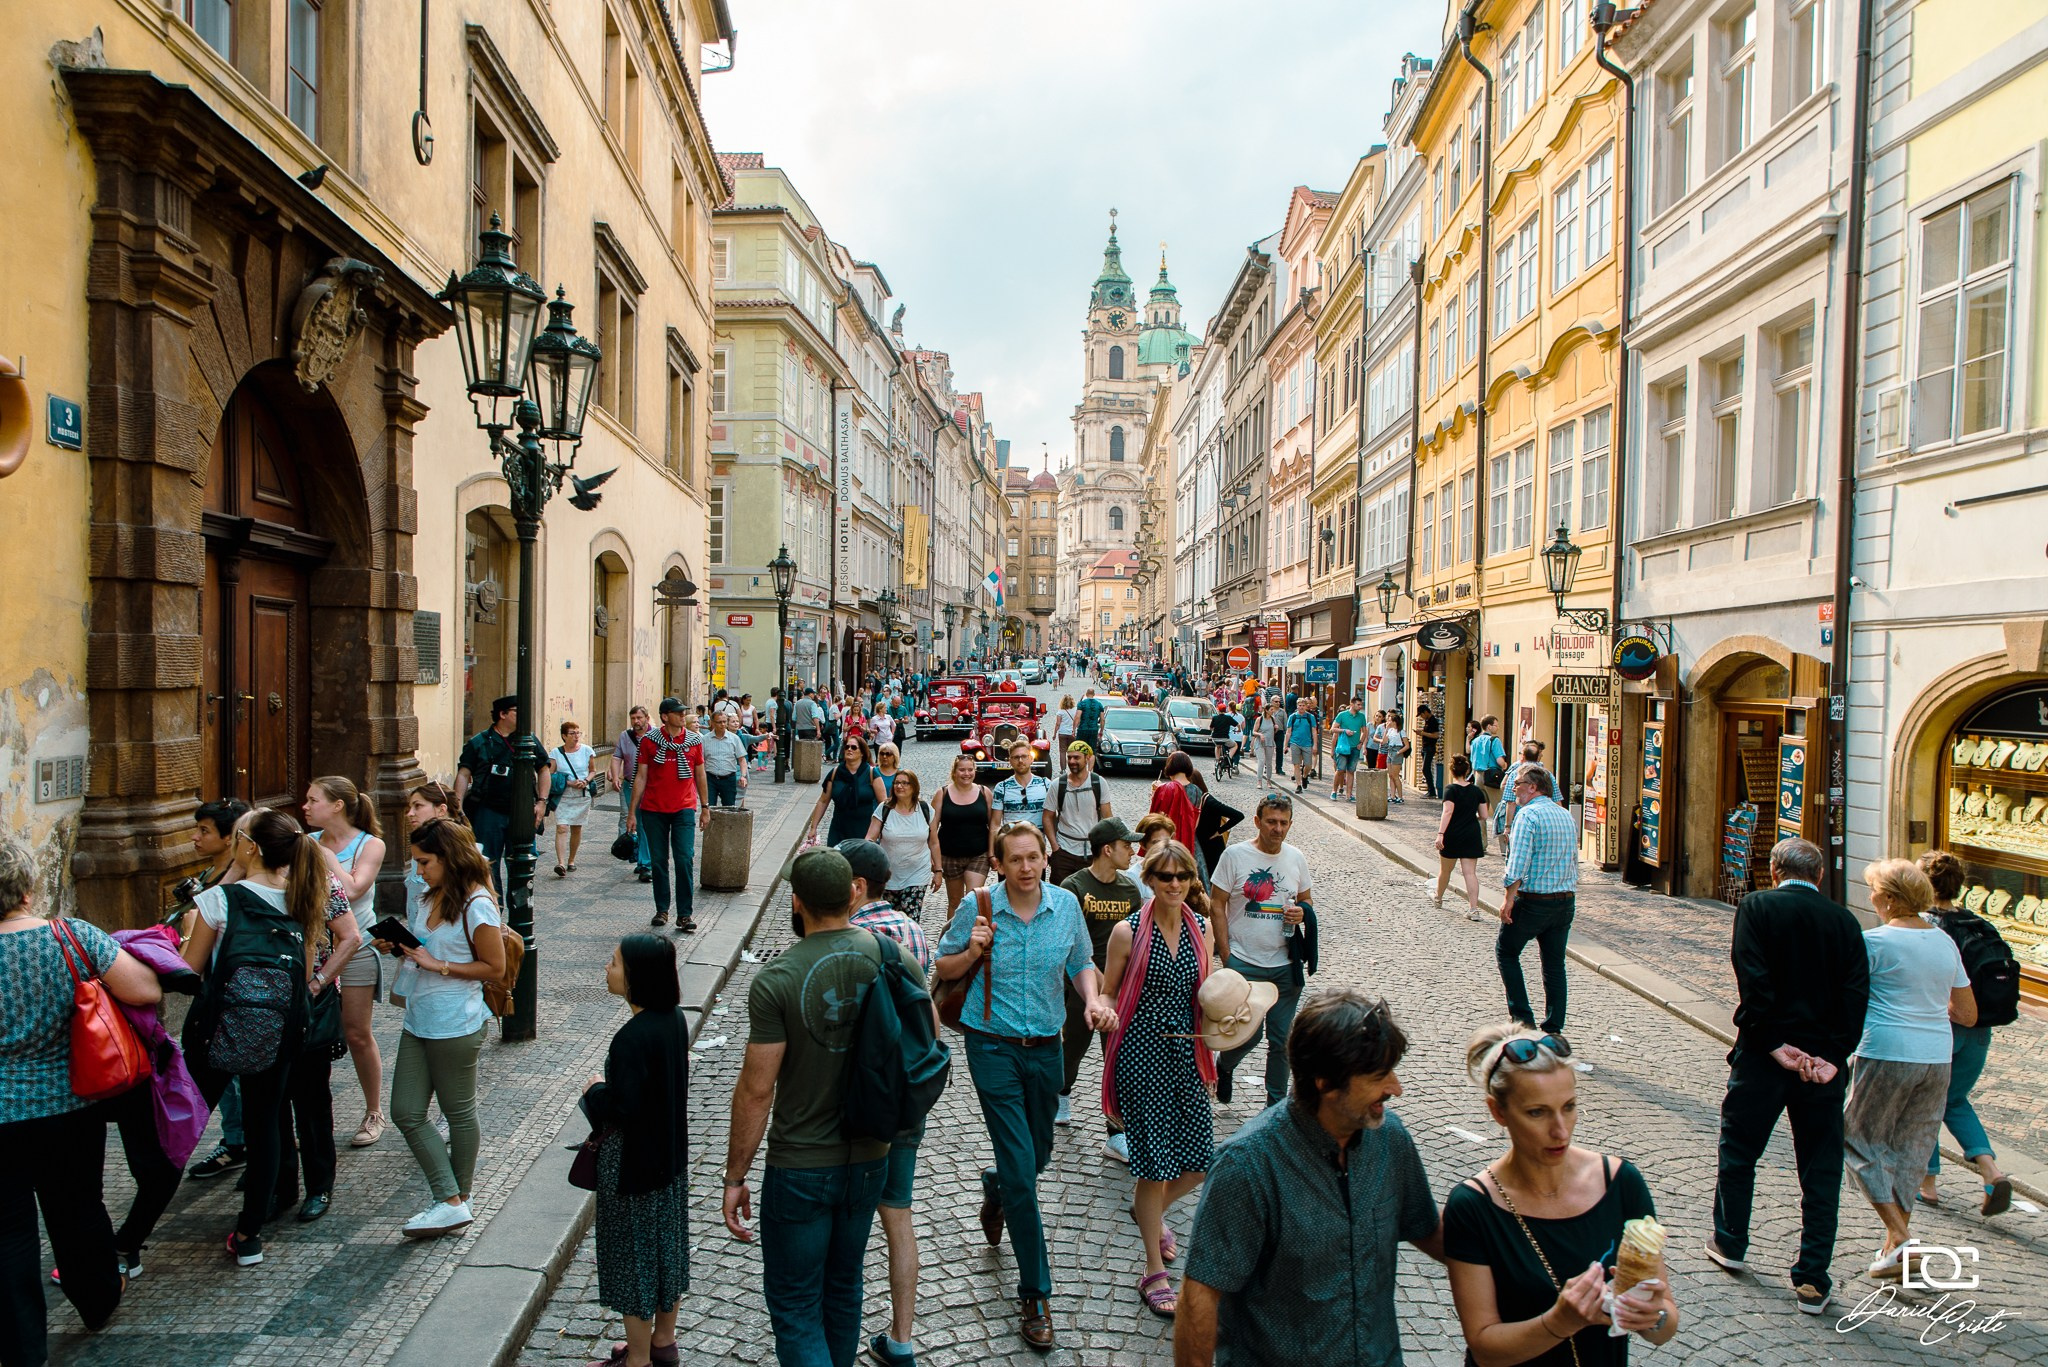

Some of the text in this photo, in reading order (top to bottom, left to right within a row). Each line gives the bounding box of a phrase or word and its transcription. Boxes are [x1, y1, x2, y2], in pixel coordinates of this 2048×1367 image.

[65, 407, 73, 427] 3
[839, 411, 849, 593] DESIGN HOTEL DOMUS BALTHASAR
[1822, 603, 1833, 615] 52
[1533, 635, 1546, 651] LA
[1824, 629, 1831, 642] 6
[1622, 637, 1657, 654] RESTAURACE
[1554, 651, 1586, 662] massage
[1553, 675, 1608, 696] CHANGE
[1612, 671, 1620, 687] NO
[1561, 696, 1609, 704] COMMISSION
[1612, 690, 1621, 727] LIMIT
[42, 782, 50, 797] 3
[1610, 747, 1621, 821] COMMISSION
[1609, 825, 1620, 862] NETTO
[1265, 913, 1272, 921] &
